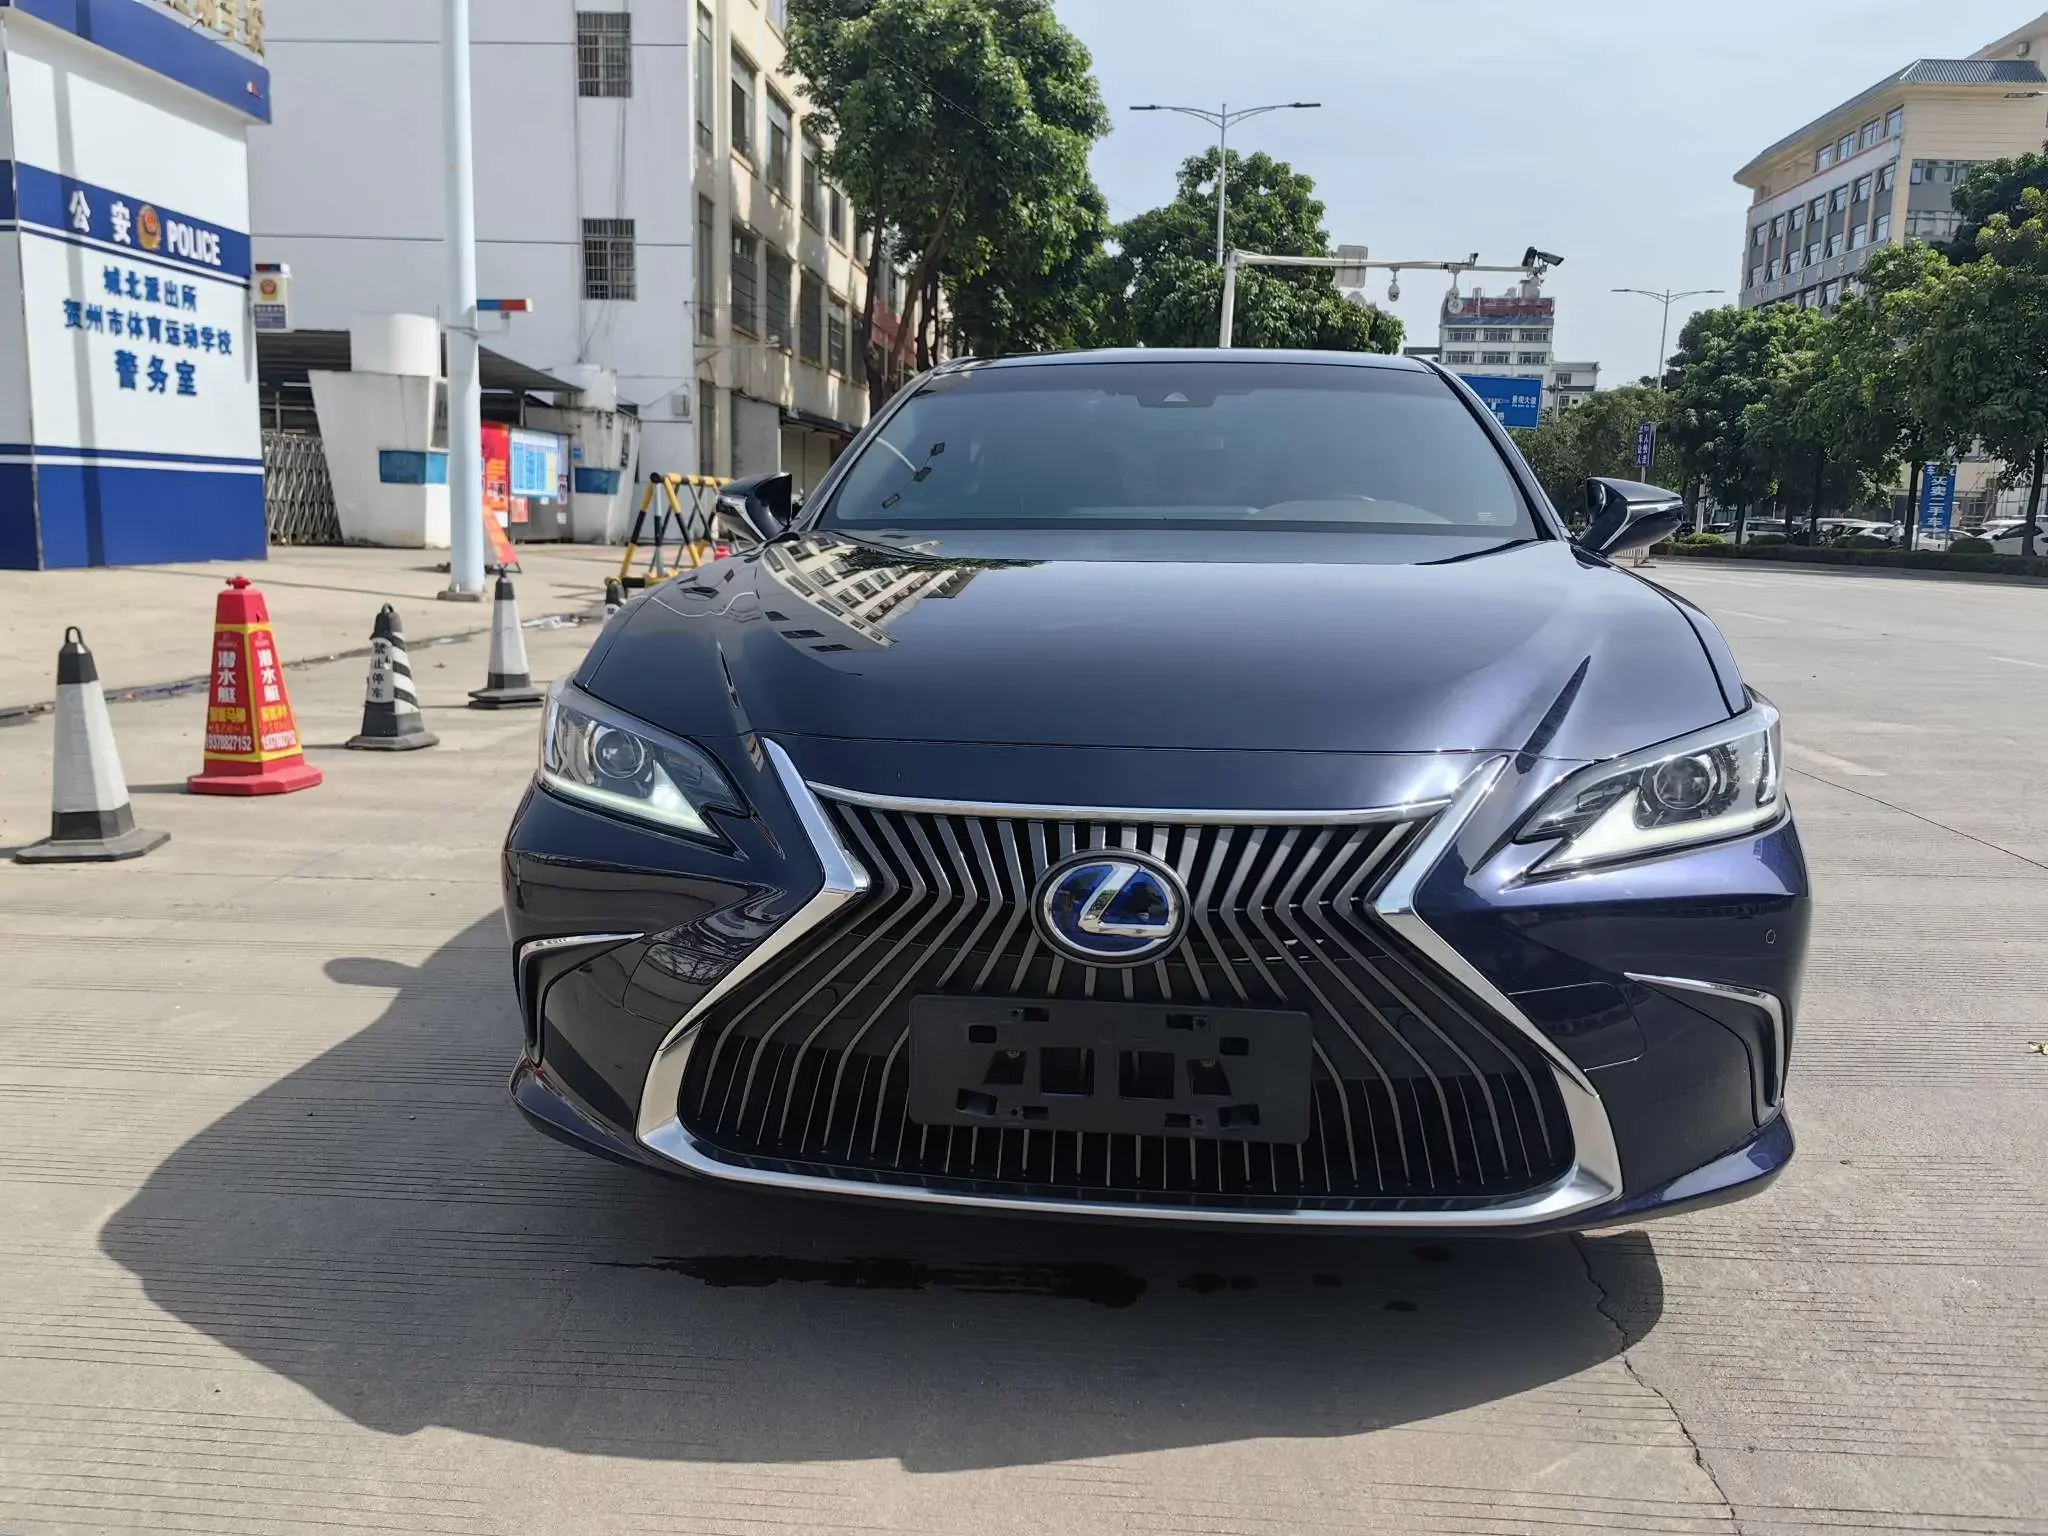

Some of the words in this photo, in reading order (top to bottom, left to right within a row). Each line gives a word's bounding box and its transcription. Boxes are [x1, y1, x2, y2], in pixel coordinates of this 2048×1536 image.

[69, 190, 131, 244] 公安
[167, 220, 221, 266] POLICE
[103, 265, 197, 312] 城北派出所
[63, 298, 233, 356] 贺州市体育运动学校
[115, 349, 198, 397] 警务室
[1927, 476, 1947, 528] 买卖二手车
